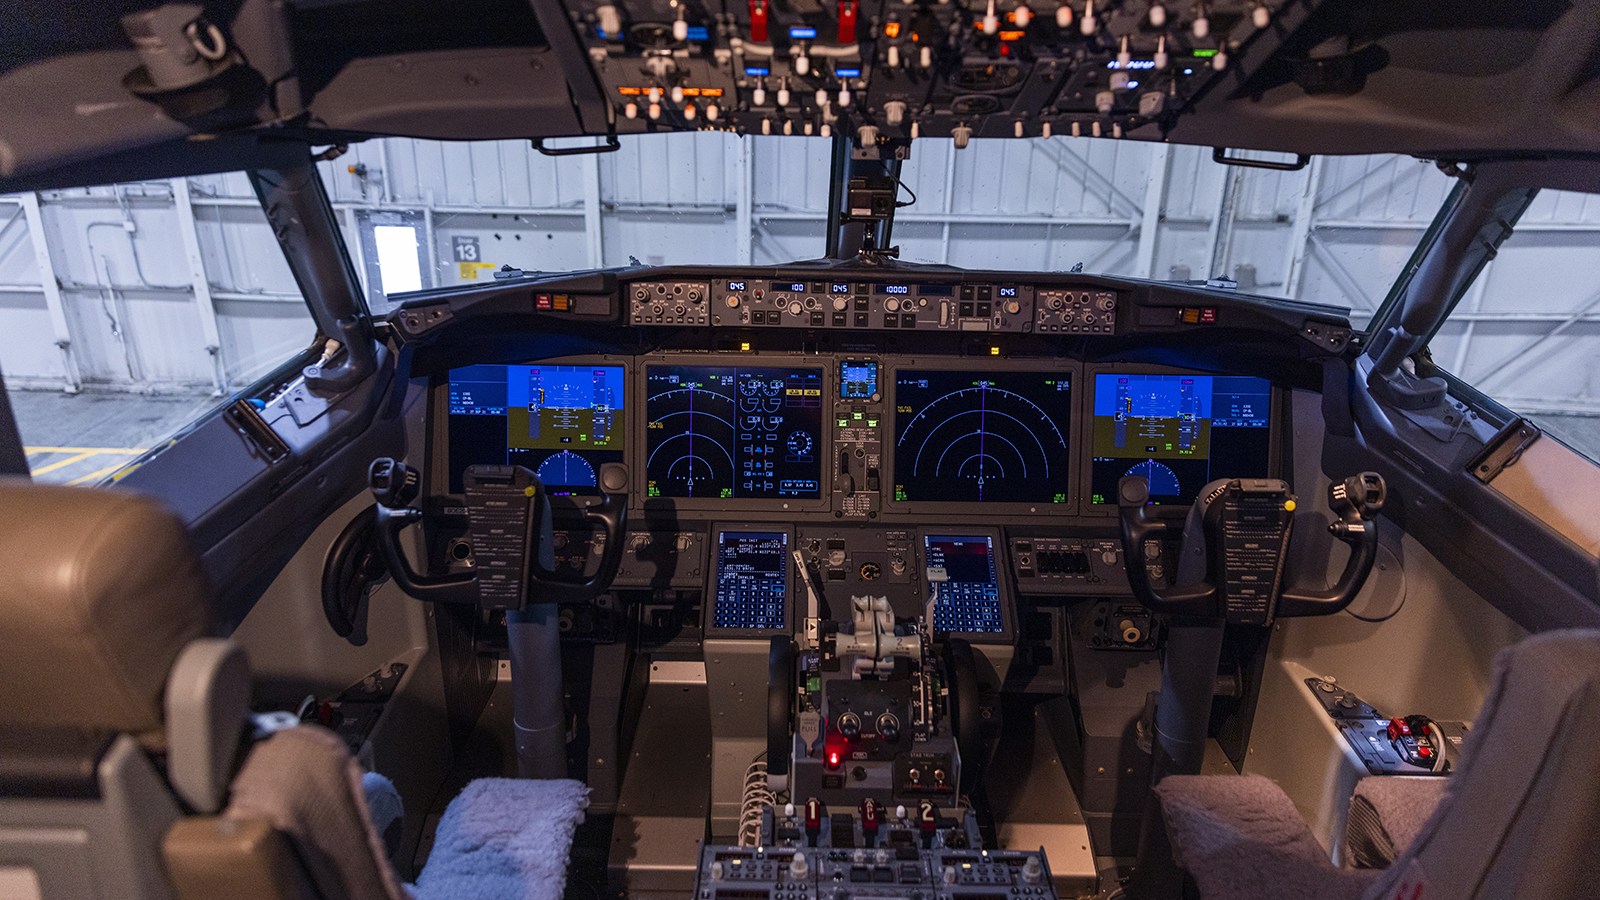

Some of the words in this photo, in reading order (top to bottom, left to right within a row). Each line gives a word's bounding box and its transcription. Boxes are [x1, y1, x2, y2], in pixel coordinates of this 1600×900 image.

[456, 244, 476, 260] 13
[730, 282, 744, 290] 045
[854, 636, 858, 644] 1
[897, 637, 903, 646] 2
[809, 802, 816, 820] 1
[866, 801, 874, 820] APU
[921, 803, 934, 821] 2
